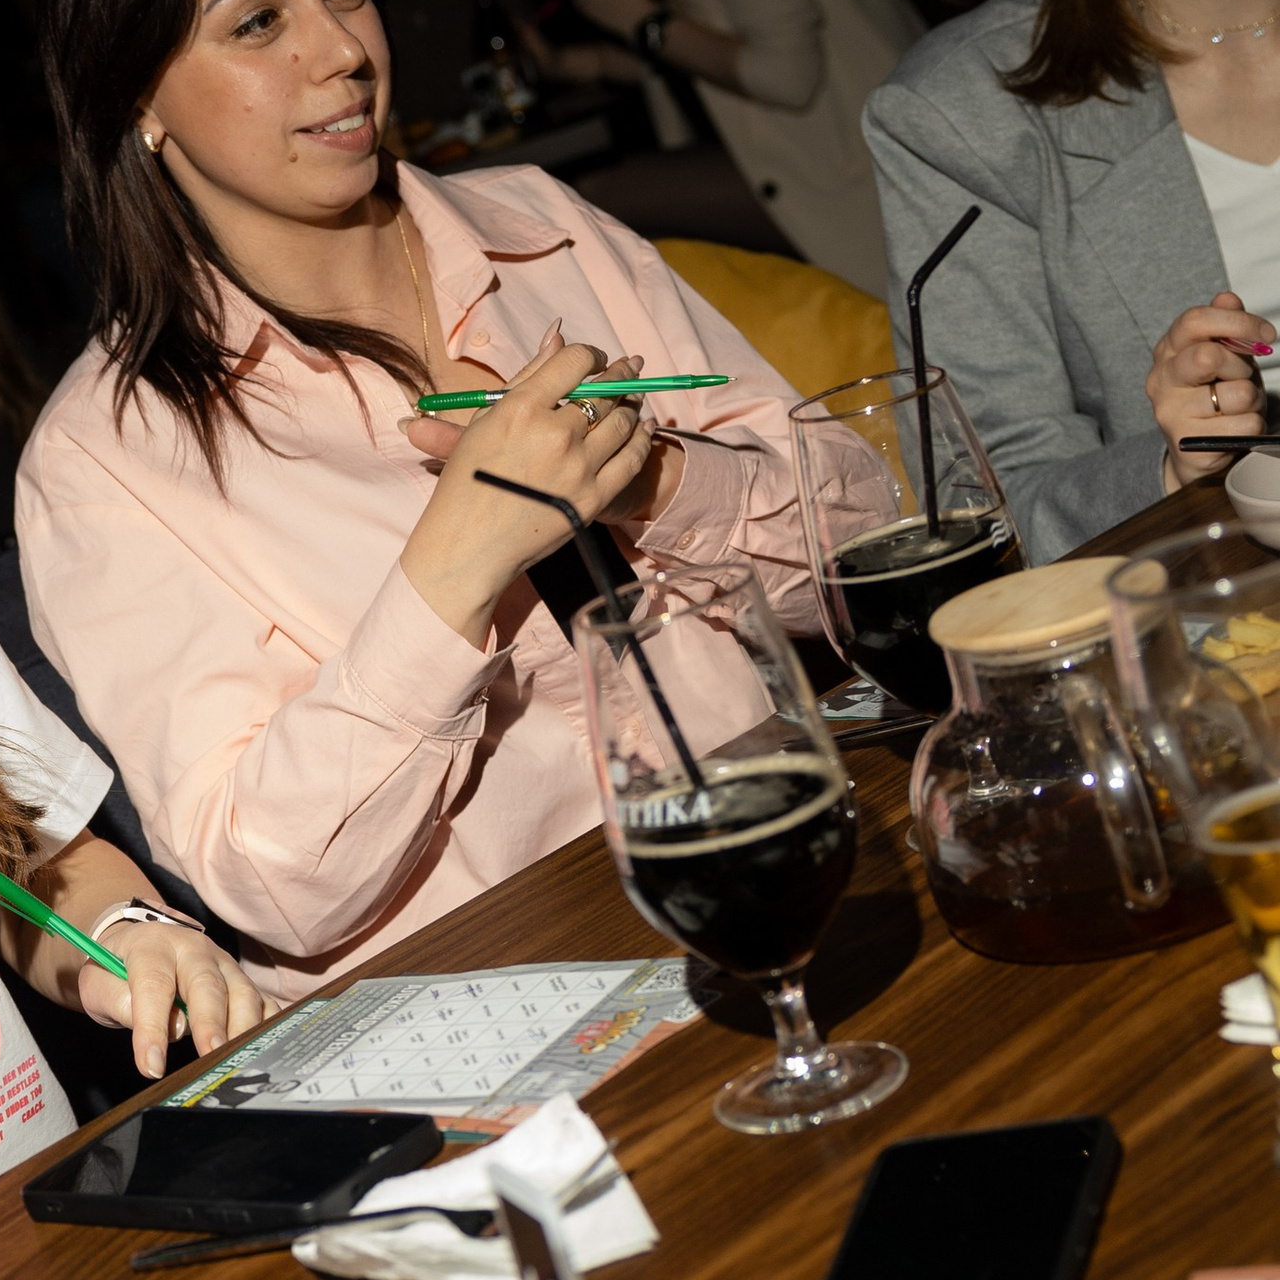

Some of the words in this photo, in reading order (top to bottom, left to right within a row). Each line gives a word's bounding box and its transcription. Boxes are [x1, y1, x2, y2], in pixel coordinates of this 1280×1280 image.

[2, 1070, 17, 1086] HER
[17, 1054, 37, 1077] VOICE
[6, 1069, 41, 1100] RESTLESS
[5, 1099, 30, 1119] UNDER
[30, 1084, 43, 1101] TOO
[21, 1099, 45, 1124] CRACK.
